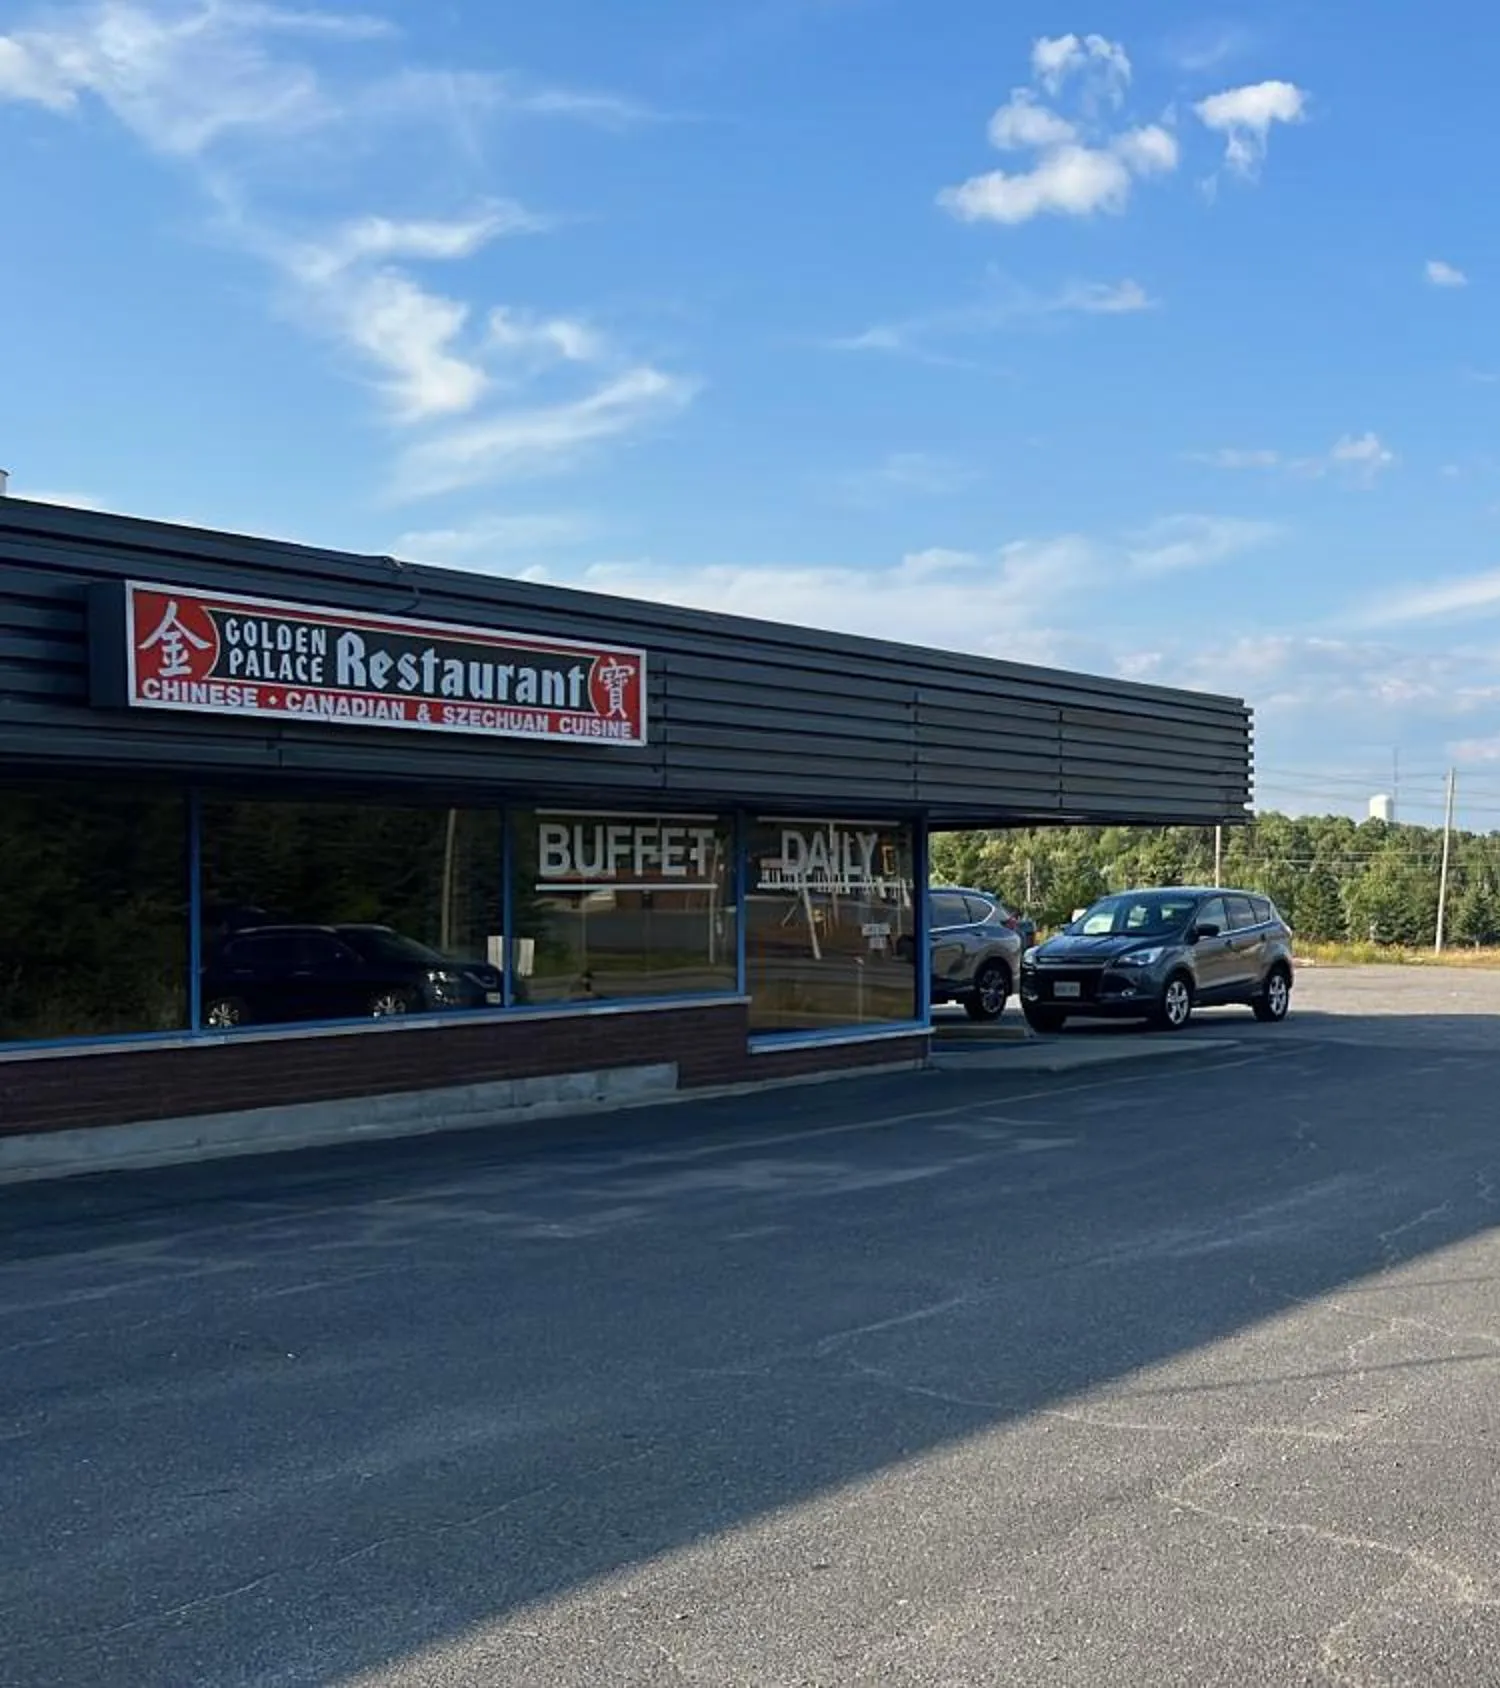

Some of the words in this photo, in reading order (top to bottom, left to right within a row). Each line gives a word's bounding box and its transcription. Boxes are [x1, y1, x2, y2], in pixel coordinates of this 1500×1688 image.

[137, 600, 213, 677] 金
[225, 617, 327, 656] GOLDEN
[228, 647, 323, 683] PALACE
[336, 631, 585, 707] Restaurant
[142, 678, 259, 707] CHINESE
[285, 691, 405, 721] CANADIAN
[417, 703, 431, 721] &
[443, 705, 549, 733] SZECHUAN
[559, 716, 632, 738] CUISINE
[539, 823, 714, 877] BUFFET
[781, 830, 879, 876] DAILY
